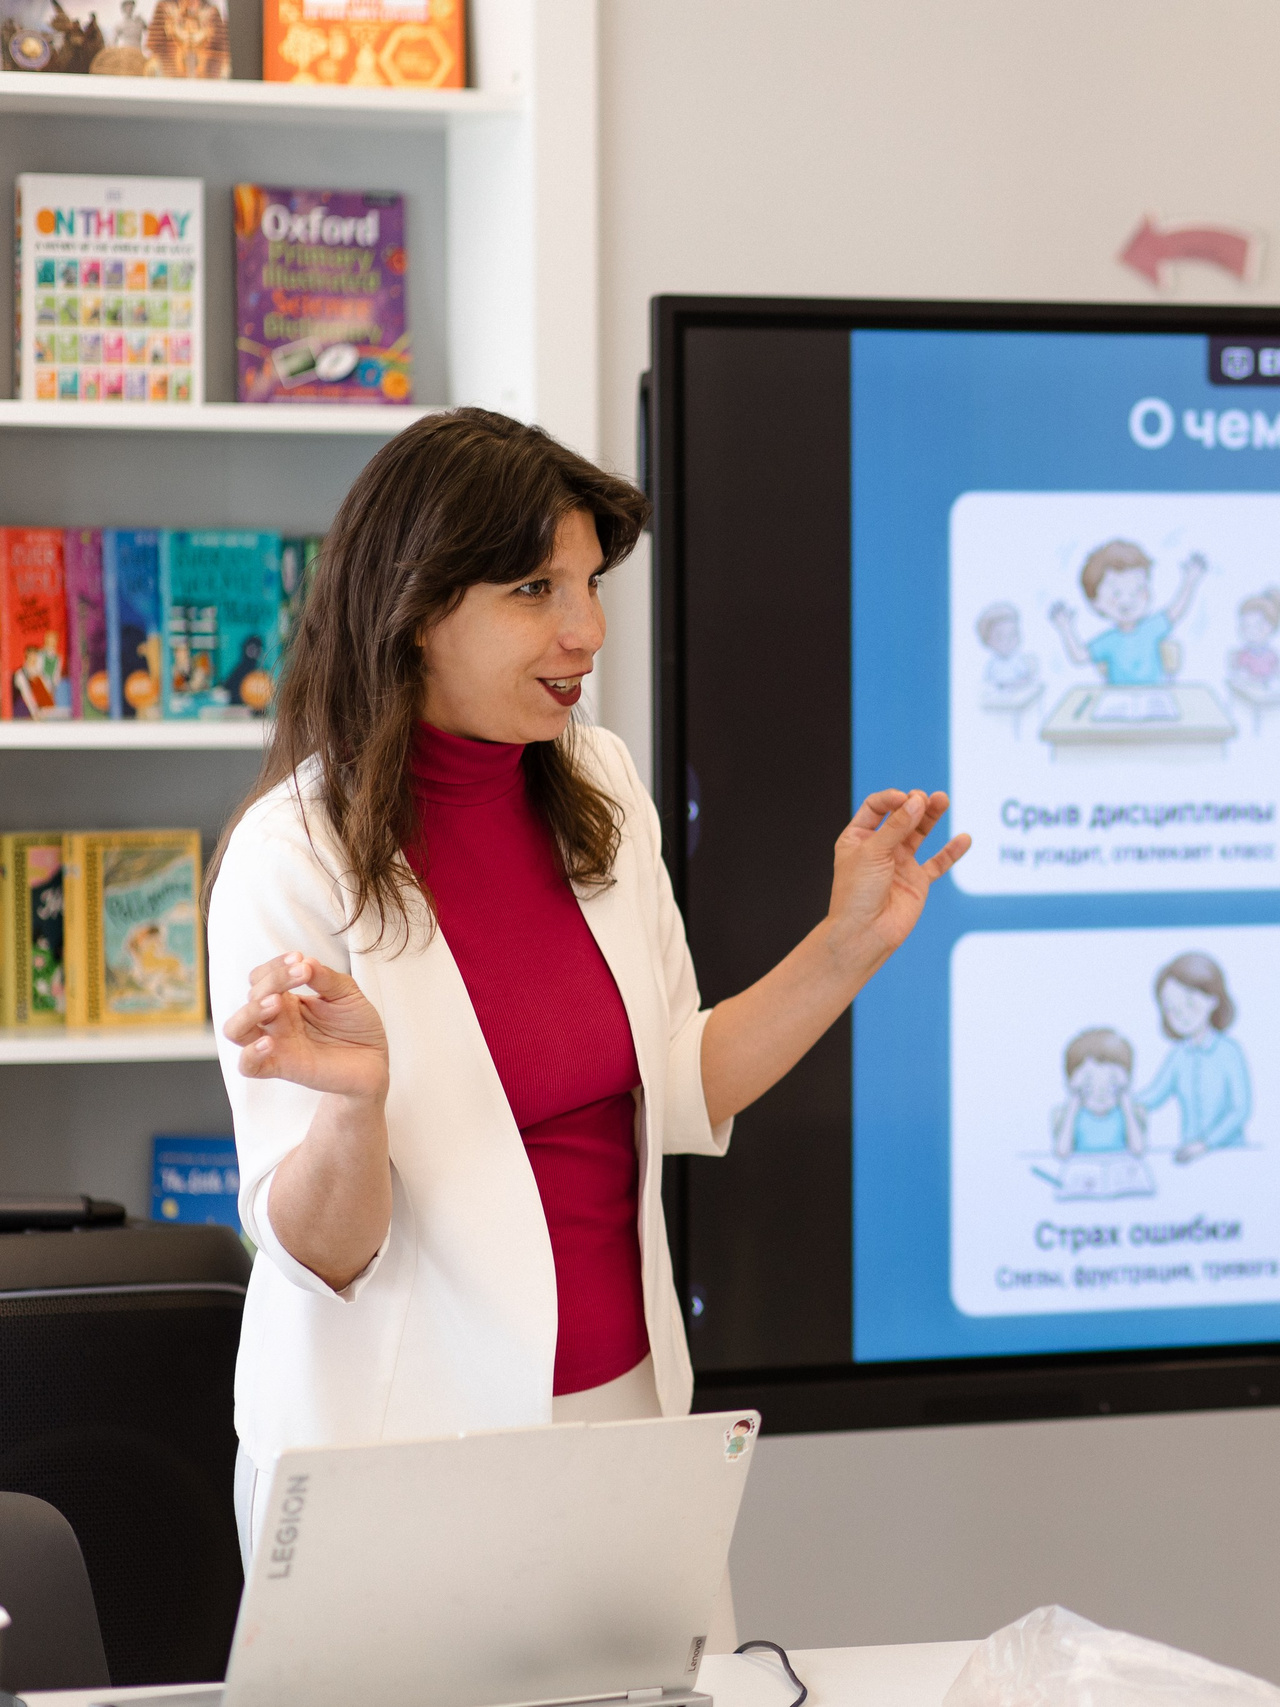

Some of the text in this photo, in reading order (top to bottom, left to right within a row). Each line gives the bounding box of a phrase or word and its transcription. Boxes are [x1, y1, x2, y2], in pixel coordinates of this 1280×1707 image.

[36, 208, 191, 240] ON THIS DAY
[261, 204, 380, 246] Oxford
[1129, 398, 1174, 449] О
[1001, 797, 1275, 832] Срыв дисциплины
[1034, 1212, 1242, 1256] Страх ошибки
[267, 1473, 309, 1579] LEGION
[688, 1639, 703, 1672] Lenovo
